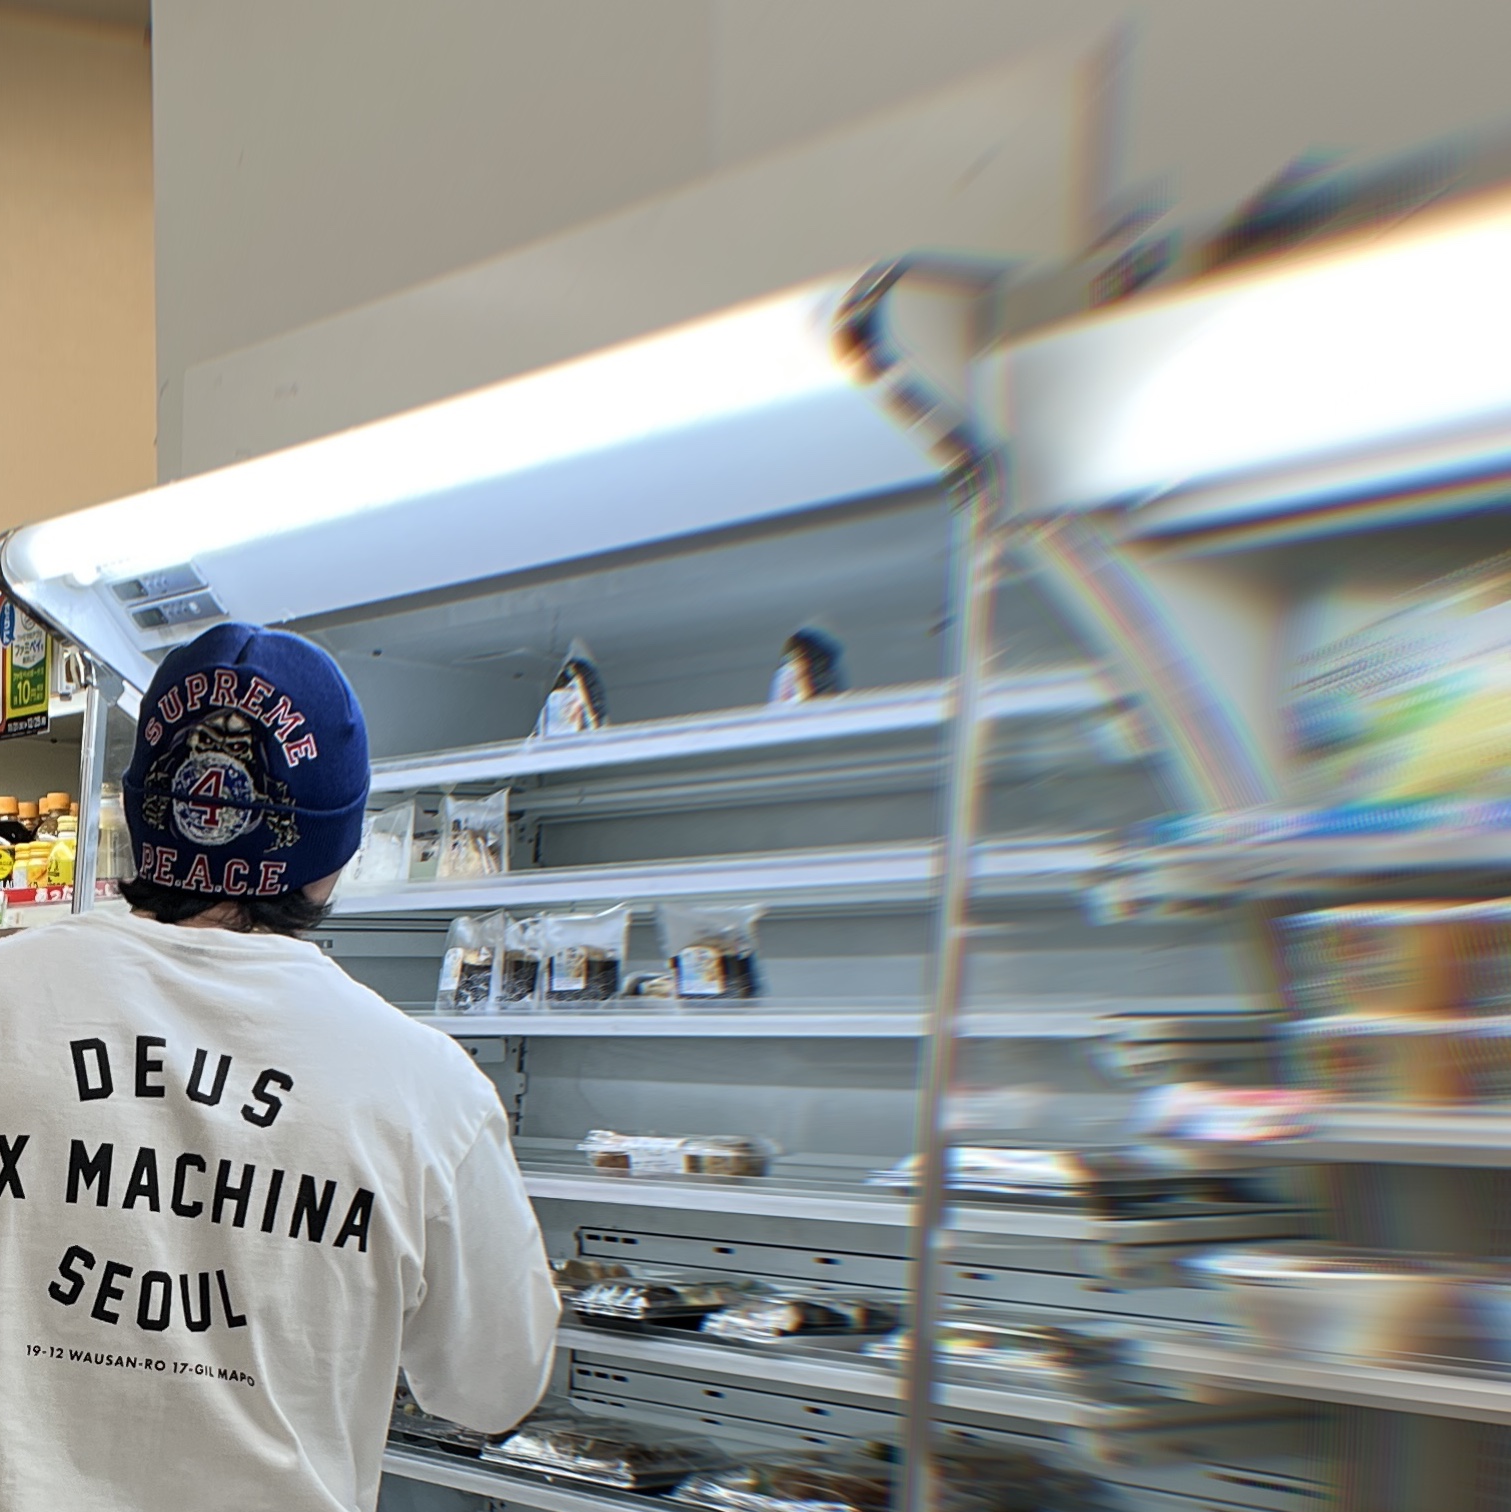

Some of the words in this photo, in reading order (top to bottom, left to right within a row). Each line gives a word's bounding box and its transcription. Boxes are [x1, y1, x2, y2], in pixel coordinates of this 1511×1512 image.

[144, 669, 317, 767] SUPREME
[189, 767, 227, 827] 4
[70, 1035, 294, 1128] DEUS
[65, 1138, 375, 1253] MACHINA
[48, 1245, 248, 1332] SEOUL
[26, 1344, 64, 1359] 19-12
[69, 1349, 166, 1371] WAUSAN-RO
[172, 1362, 214, 1378] 17-GIL
[217, 1368, 256, 1387] MAPO
